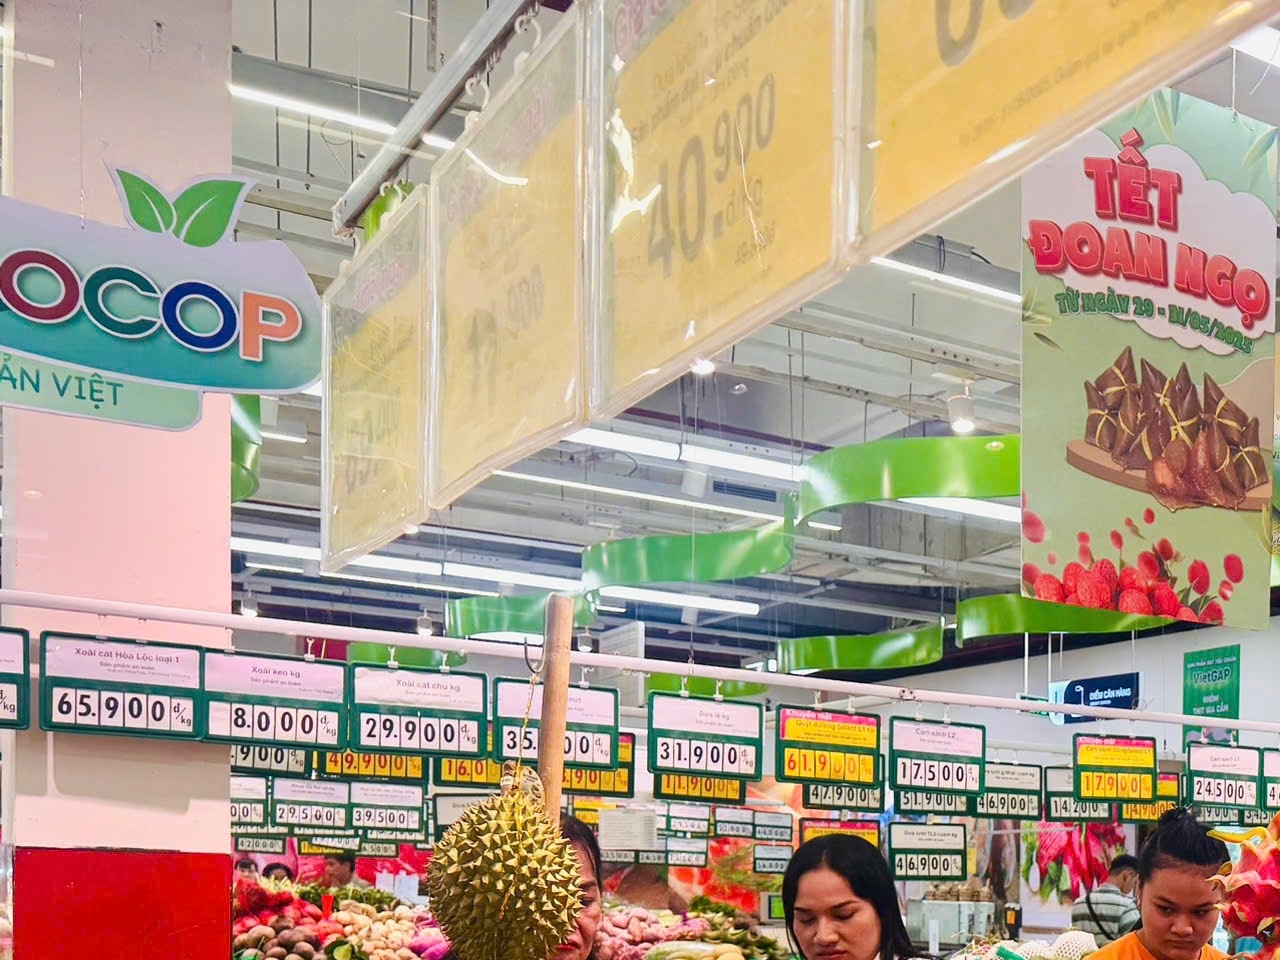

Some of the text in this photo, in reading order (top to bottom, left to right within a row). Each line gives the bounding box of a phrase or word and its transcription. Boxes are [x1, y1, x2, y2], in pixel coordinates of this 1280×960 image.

[1083, 127, 1183, 231] TẾT
[1027, 218, 1271, 330] ĐOAN NGỌ
[0, 248, 302, 361] OCOP
[1055, 286, 1080, 315] TỪ
[1081, 286, 1130, 315] NGÀY
[51, 372, 124, 409] VIỆT
[75, 647, 97, 657] Xoài
[98, 649, 113, 659] cát
[251, 666, 301, 679] Xoài keo kg
[1192, 667, 1231, 684] VietGAP
[450, 684, 461, 693] kg
[57, 693, 165, 721] 65.900
[233, 707, 314, 735] 8.000
[366, 718, 455, 743] 29.900
[507, 731, 590, 754] 35.00
[329, 753, 405, 770] 49.900
[660, 742, 737, 764] 31.900
[901, 761, 965, 782] 17.500
[811, 785, 867, 801] 47.900
[903, 792, 953, 806] 51.900
[1196, 779, 1244, 799] 24.500
[278, 807, 333, 821] 29.500
[978, 796, 1026, 812] 46.900
[355, 810, 406, 825] 39.500
[896, 857, 950, 872] 46.900
